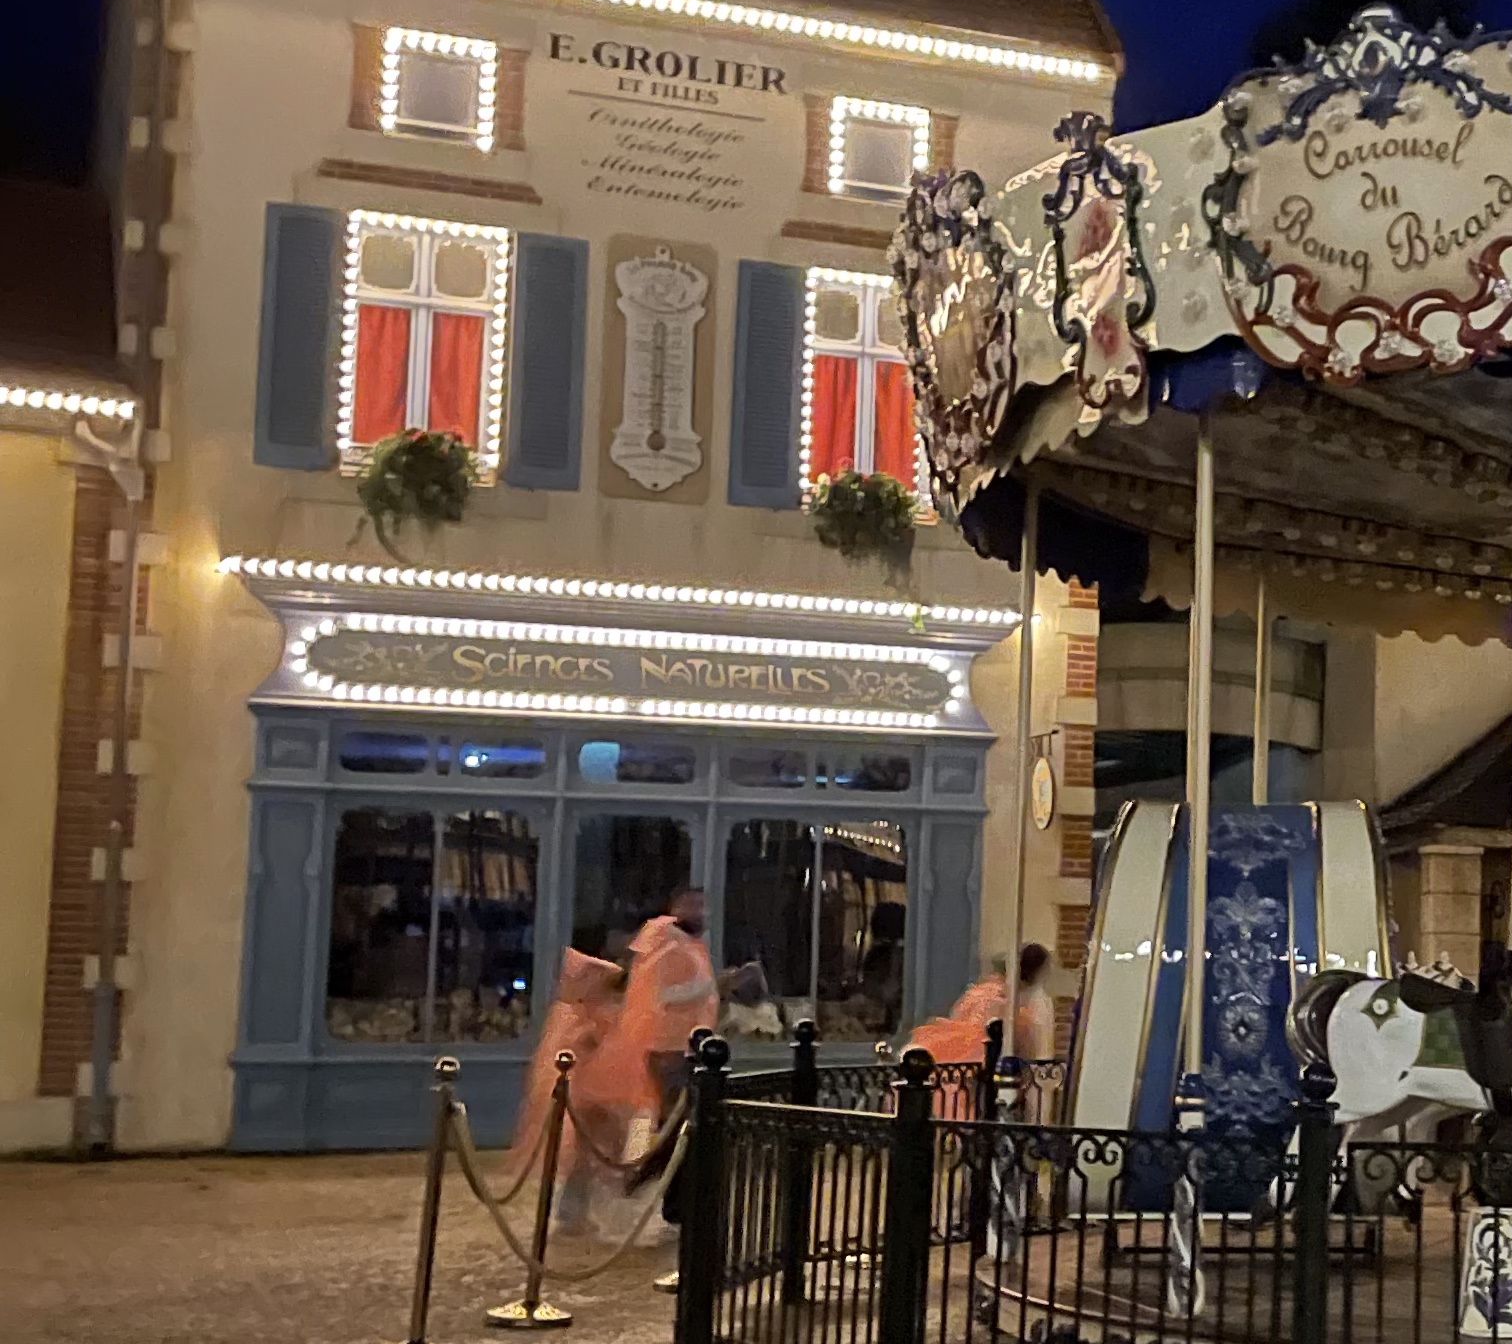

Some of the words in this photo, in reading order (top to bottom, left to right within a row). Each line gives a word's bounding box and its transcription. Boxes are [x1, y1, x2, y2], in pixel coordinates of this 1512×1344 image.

[618, 76, 642, 93] ET
[650, 82, 719, 105] FILLES
[588, 108, 744, 145] Ornithologie
[1303, 122, 1474, 179] Carrousel
[586, 175, 744, 212] Entomologie
[1360, 172, 1397, 209] du
[1273, 195, 1370, 292] Bourg
